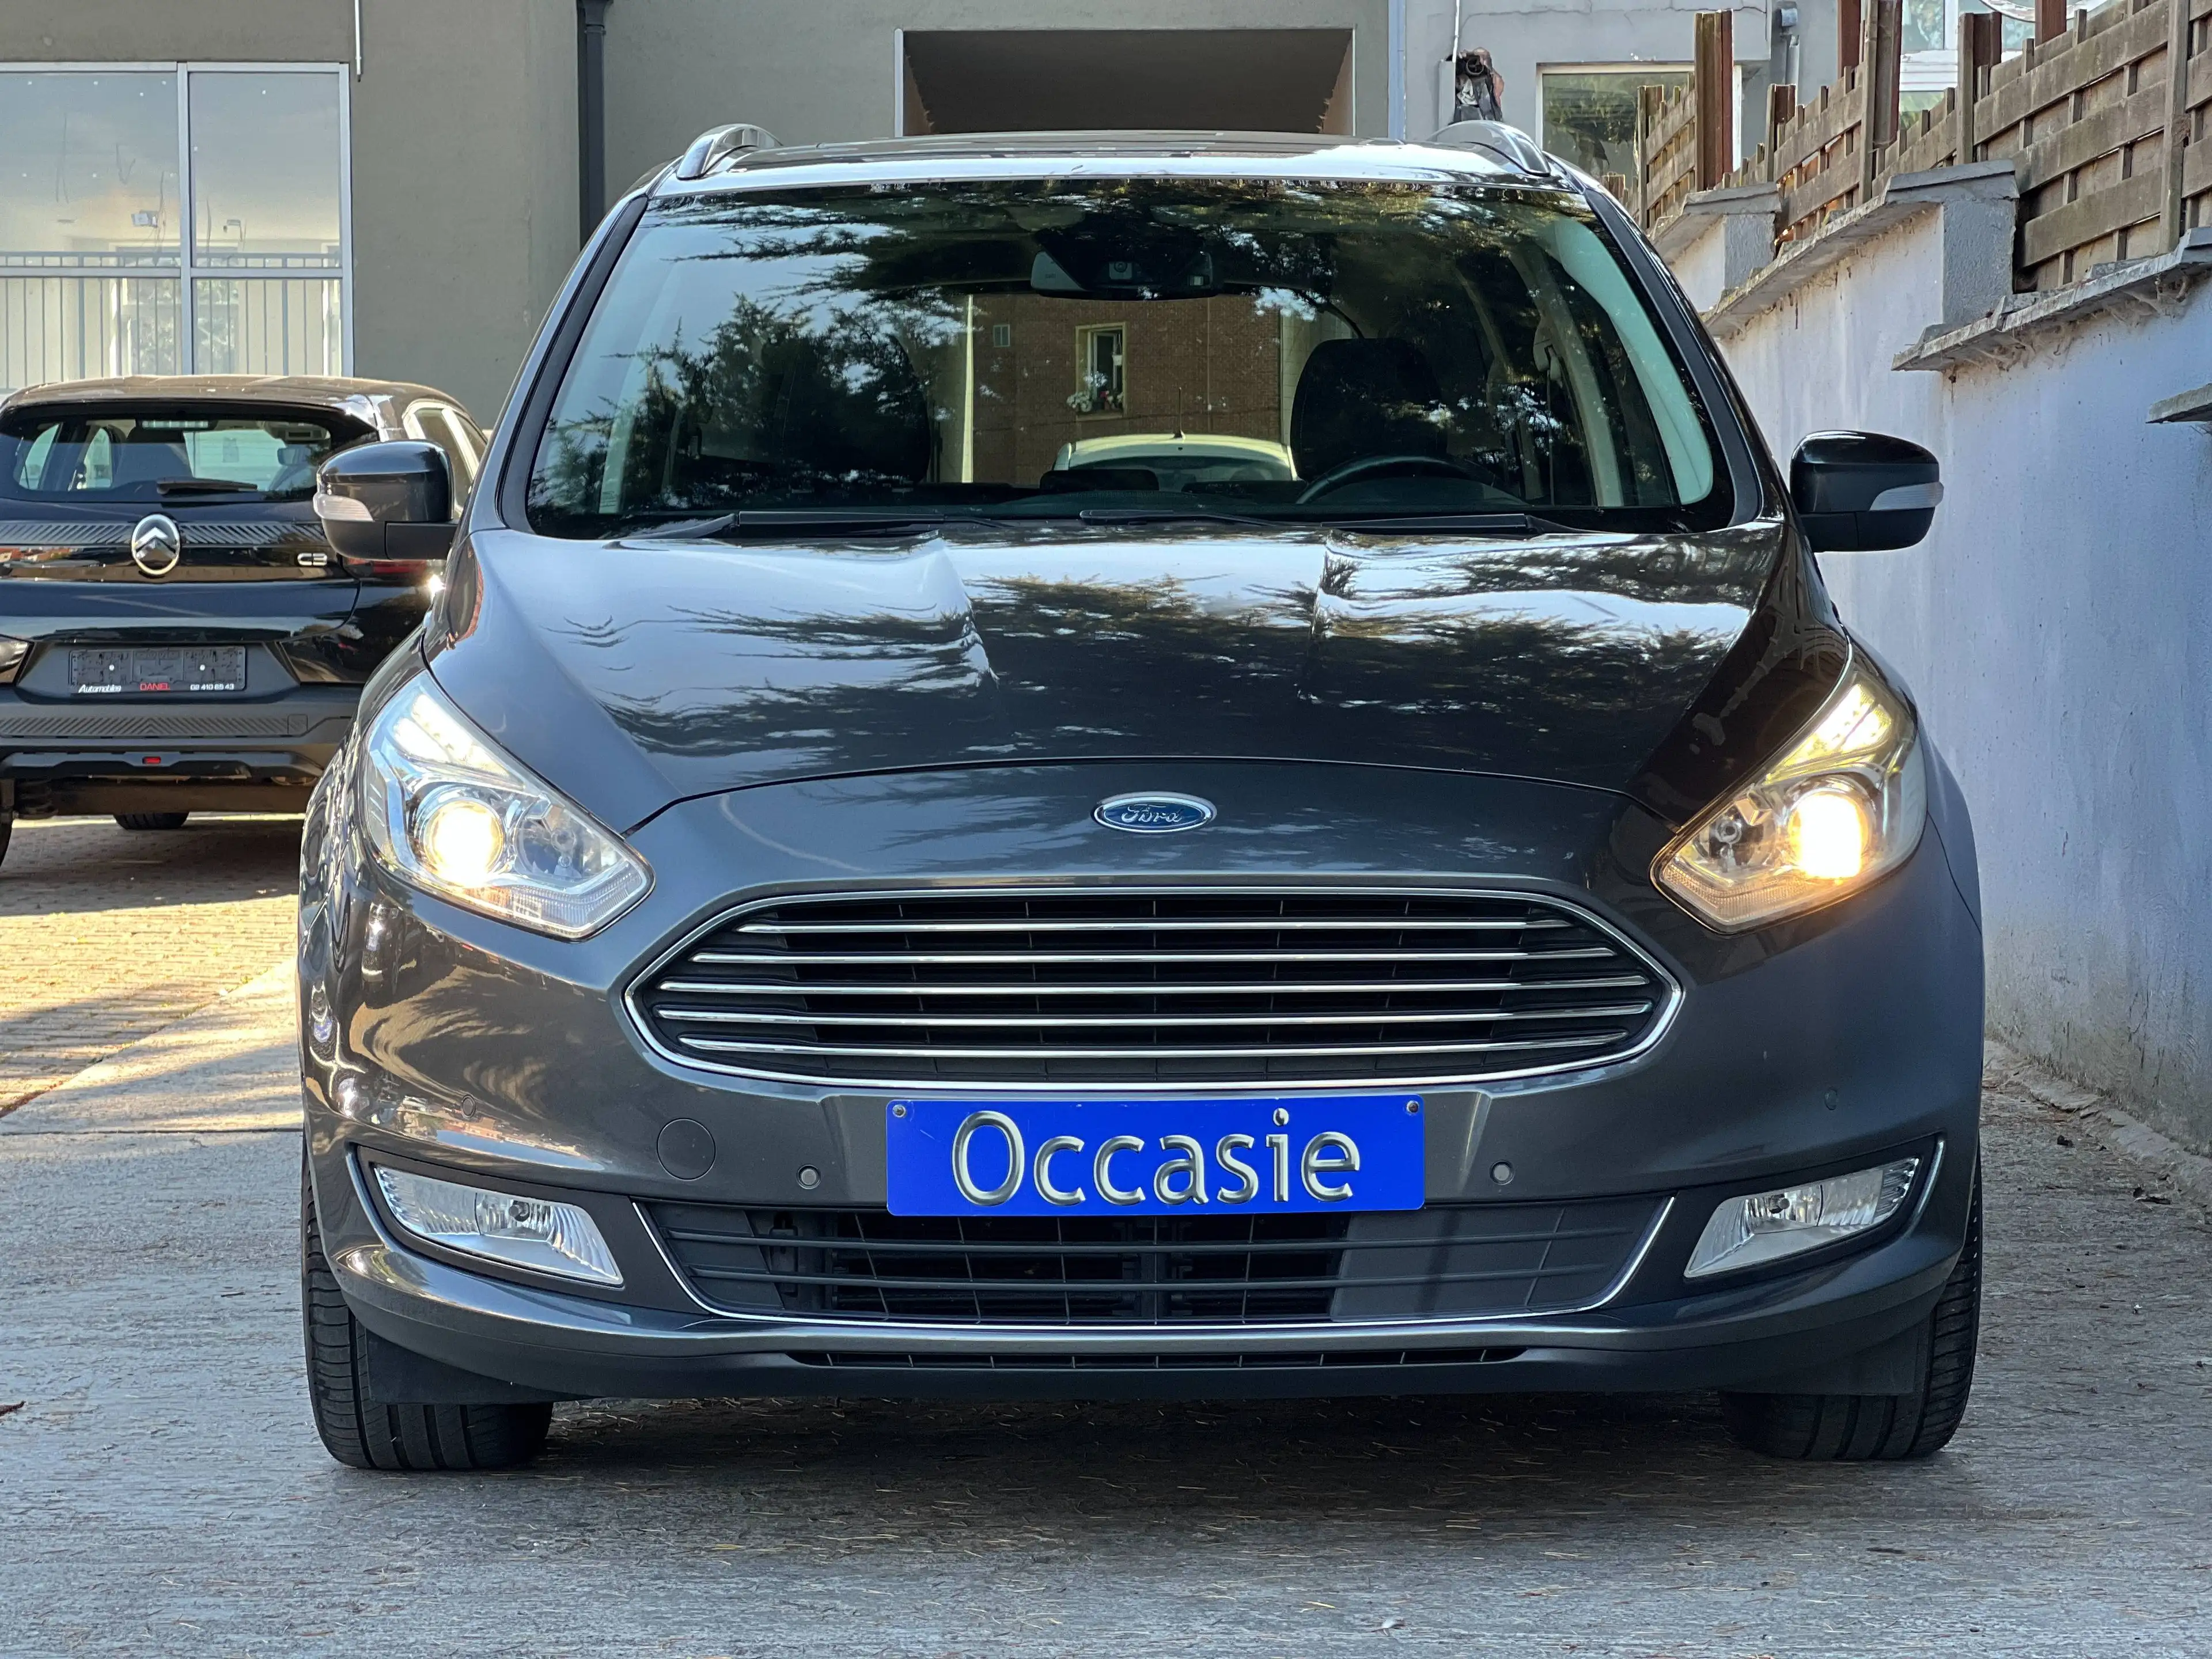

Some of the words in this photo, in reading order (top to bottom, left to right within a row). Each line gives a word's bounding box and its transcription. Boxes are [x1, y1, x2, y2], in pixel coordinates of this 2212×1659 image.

[140, 683, 171, 691] DANIEL
[1121, 804, 1185, 823] Ford
[951, 1108, 1361, 1207] Occasie
